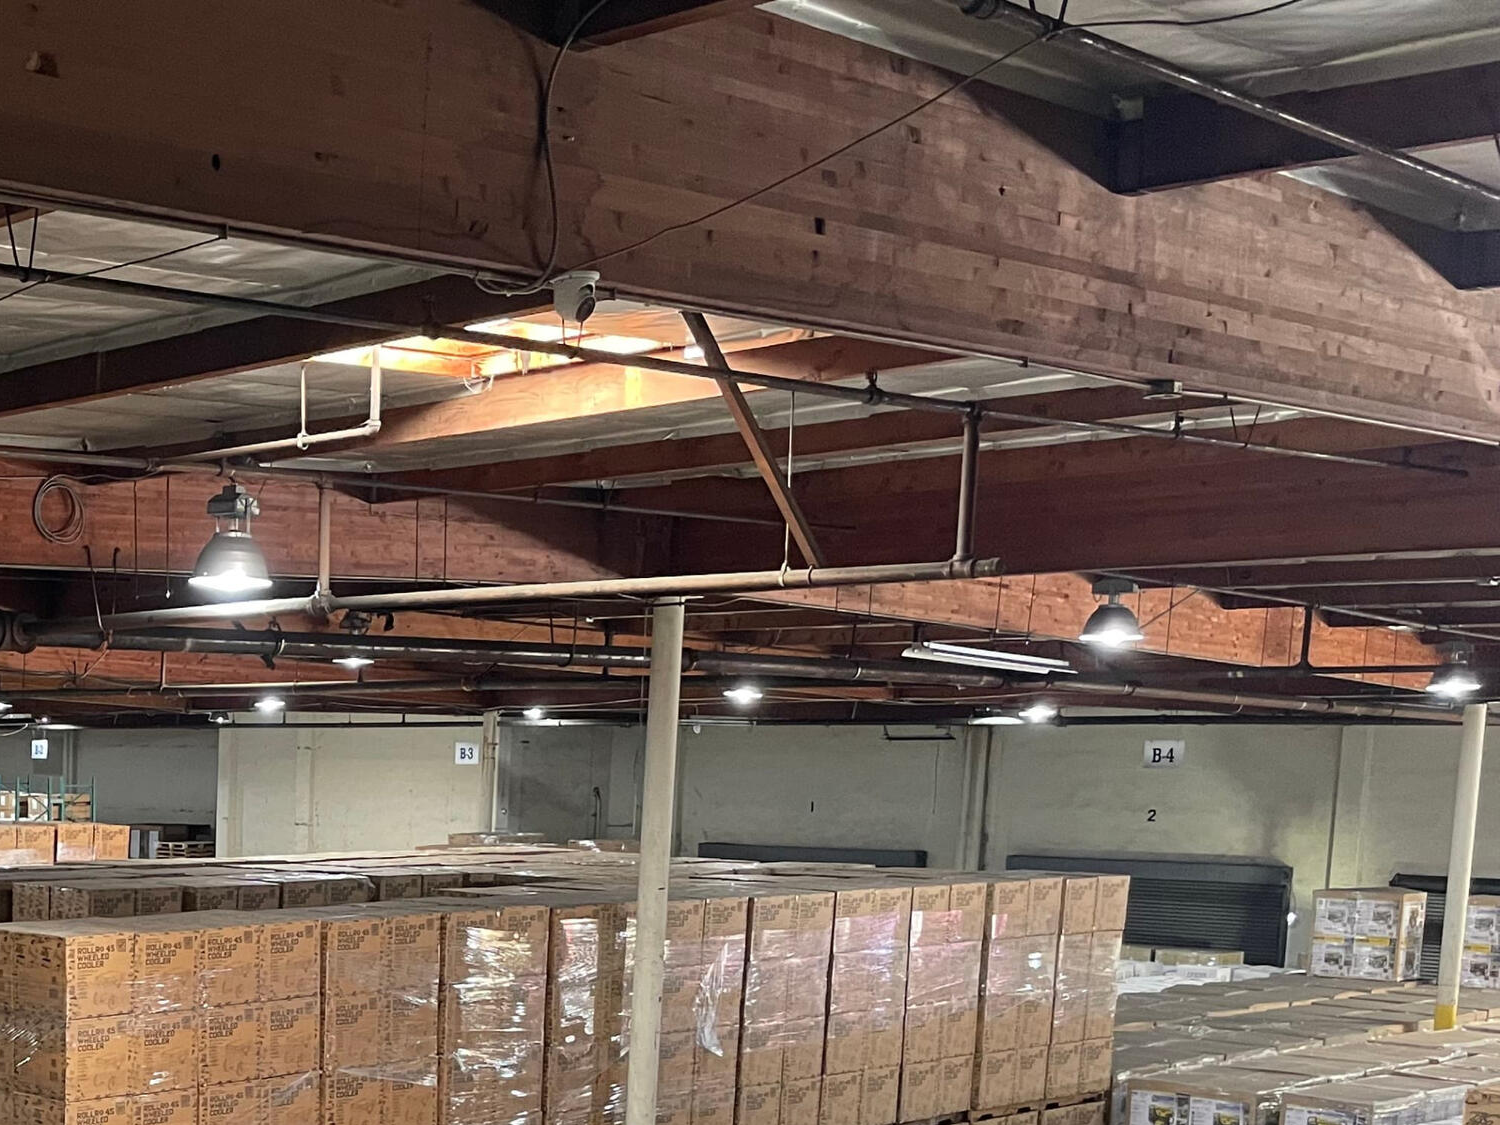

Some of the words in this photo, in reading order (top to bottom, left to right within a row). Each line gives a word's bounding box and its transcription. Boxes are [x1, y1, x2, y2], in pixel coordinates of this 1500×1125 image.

[460, 747, 474, 759] B-3
[1152, 748, 1175, 763] B-4
[1147, 809, 1157, 822] 2
